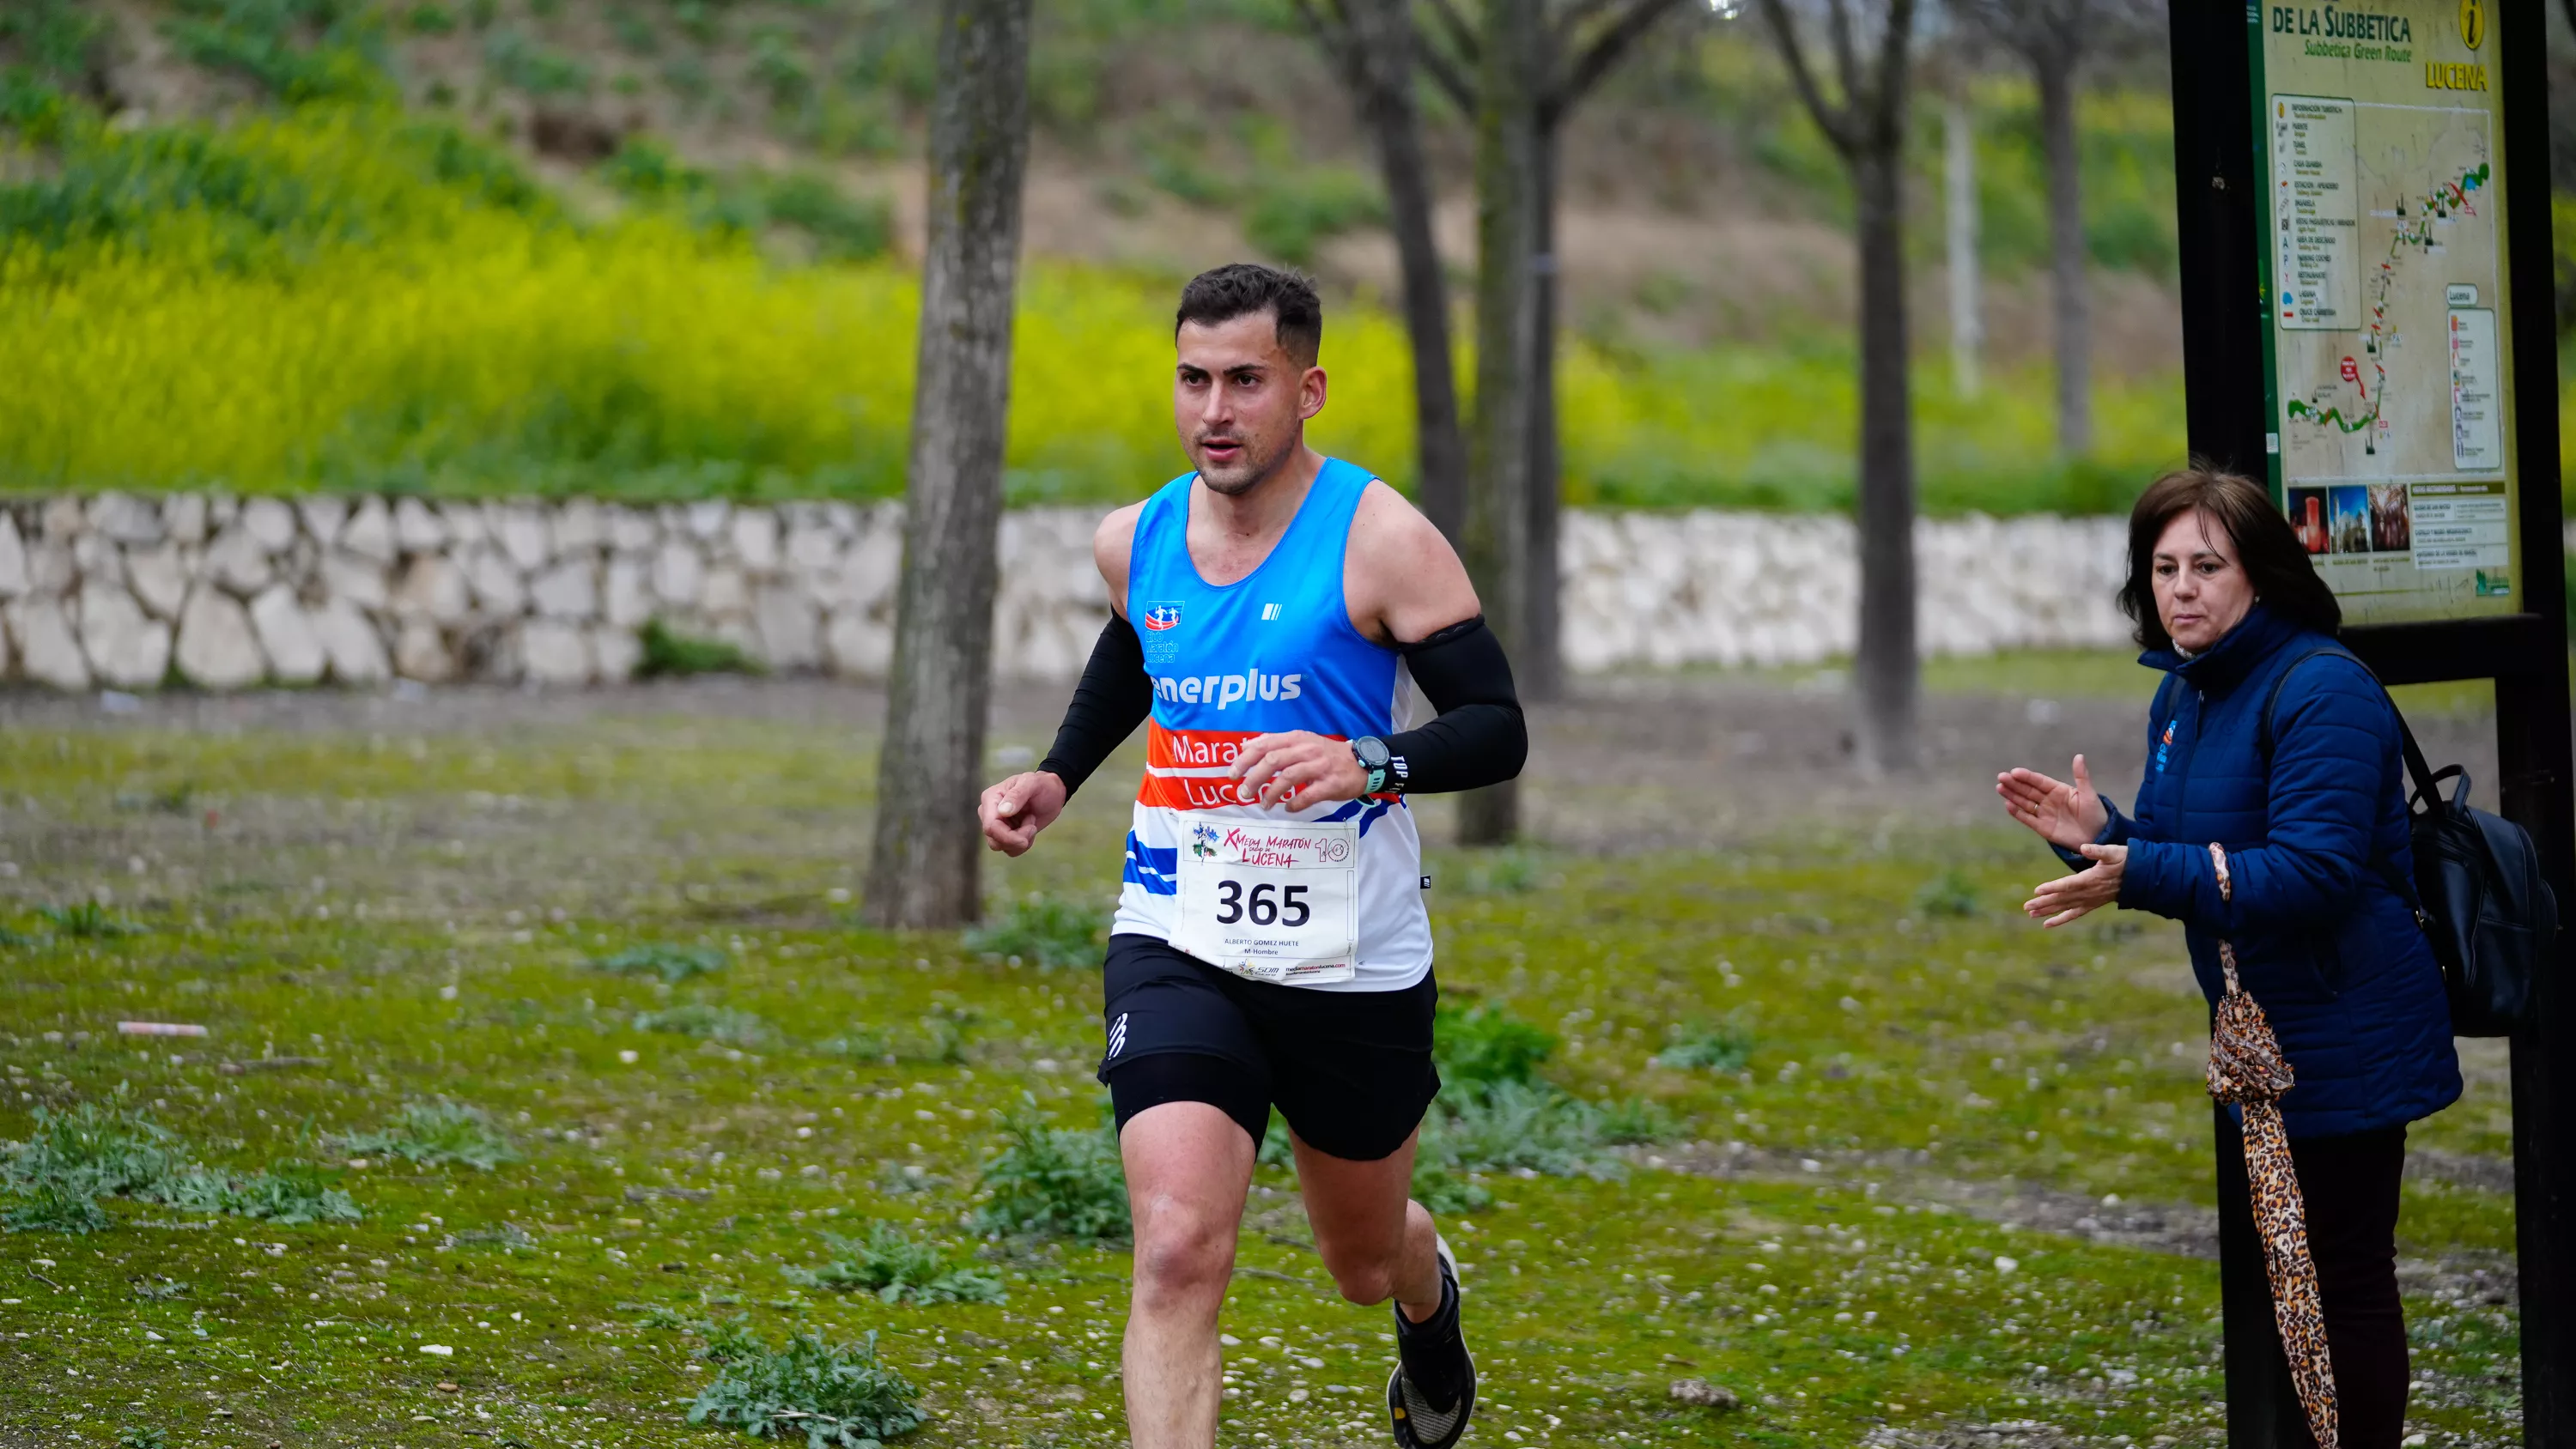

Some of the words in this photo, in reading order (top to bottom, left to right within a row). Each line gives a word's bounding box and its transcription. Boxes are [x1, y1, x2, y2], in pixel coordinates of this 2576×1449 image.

[2273, 6, 2293, 33] DE
[2300, 9, 2320, 35] LA
[2354, 43, 2383, 60] Green
[2385, 45, 2412, 63] Route
[2425, 61, 2489, 92] LUCENA
[2449, 289, 2470, 300] Lucena
[1173, 735, 1248, 764] Marat
[1390, 755, 1408, 779] TOP
[1242, 847, 1300, 869] LUCENA
[1216, 880, 1310, 927] 365
[1285, 962, 1346, 972] mediamaratonlucena.com
